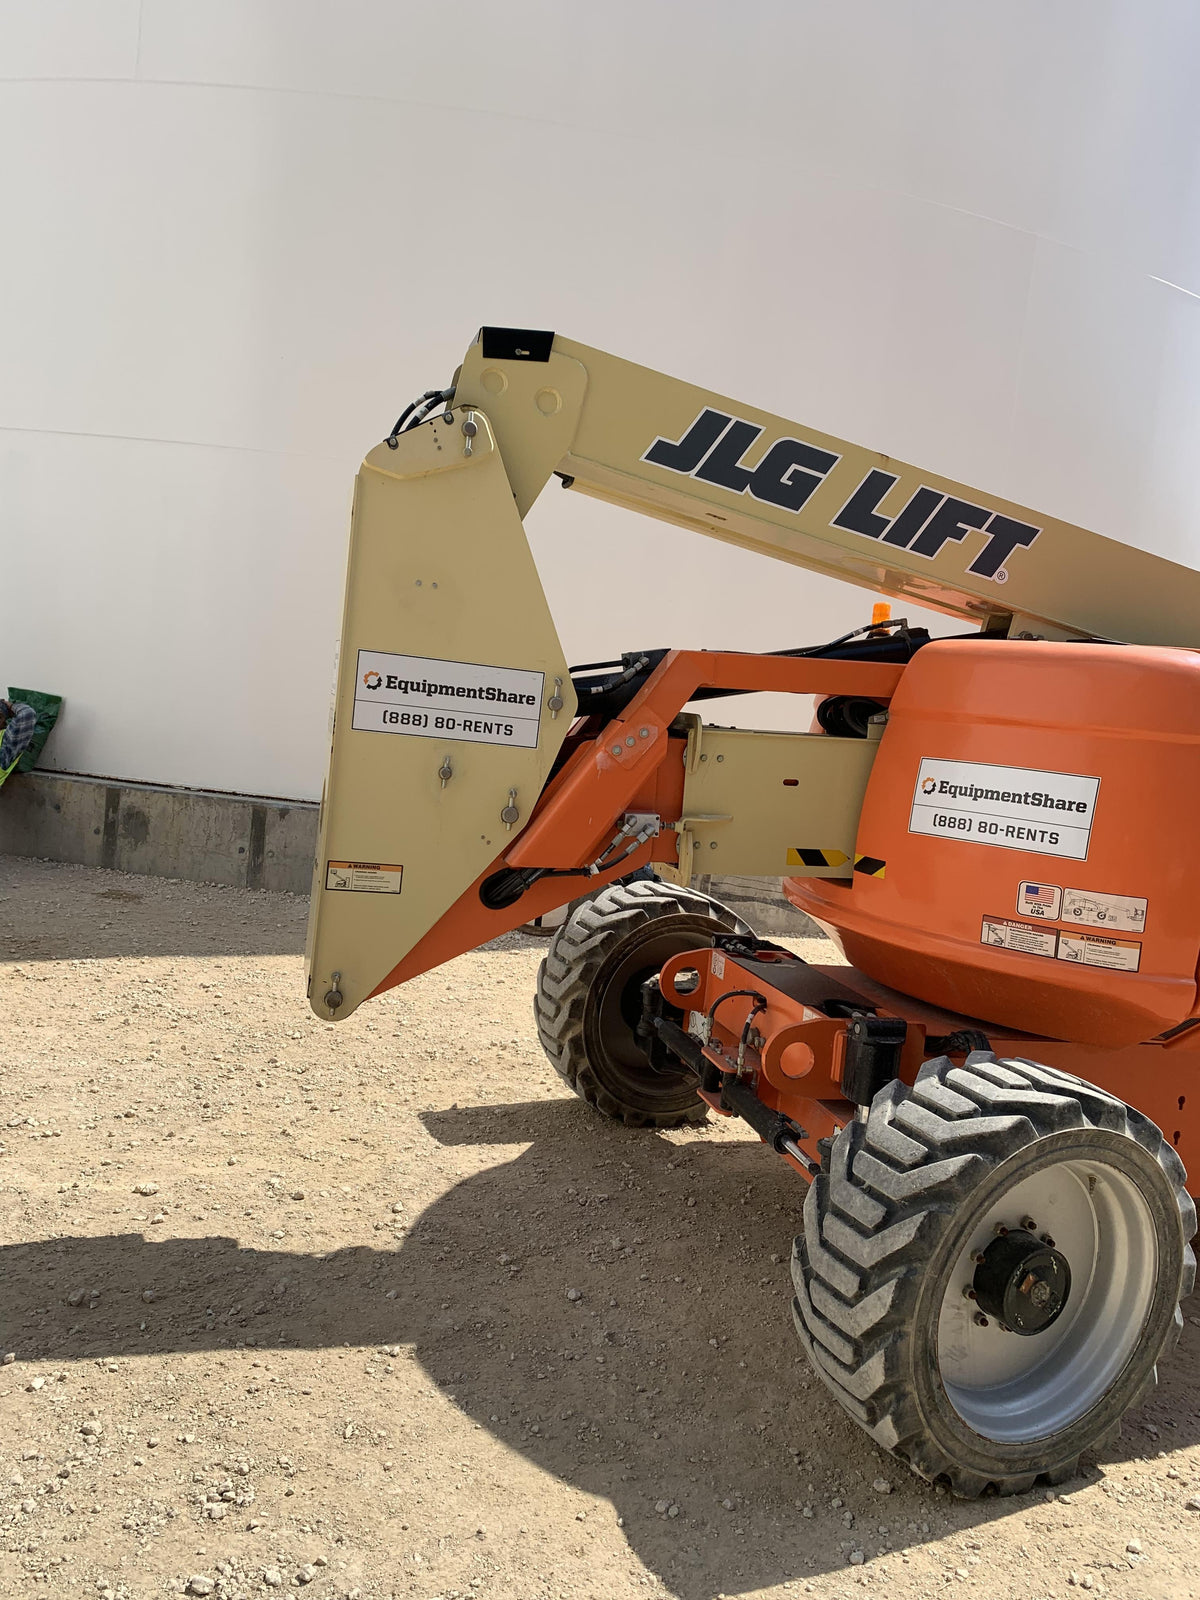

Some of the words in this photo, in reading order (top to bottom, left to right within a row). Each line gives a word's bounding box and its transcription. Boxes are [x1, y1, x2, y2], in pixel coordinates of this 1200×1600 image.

[640, 405, 843, 514] JLG
[385, 675, 536, 705] EquipmentShare
[382, 709, 428, 728] (888)
[434, 716, 514, 736] 80-RENTS
[938, 780, 1088, 813] EquipmentShare
[933, 813, 973, 832] (888)
[977, 821, 1060, 845] 80-RENTS
[1007, 921, 1033, 931] DANGER
[1030, 908, 1045, 916] USA
[1085, 936, 1117, 946] WARNING
